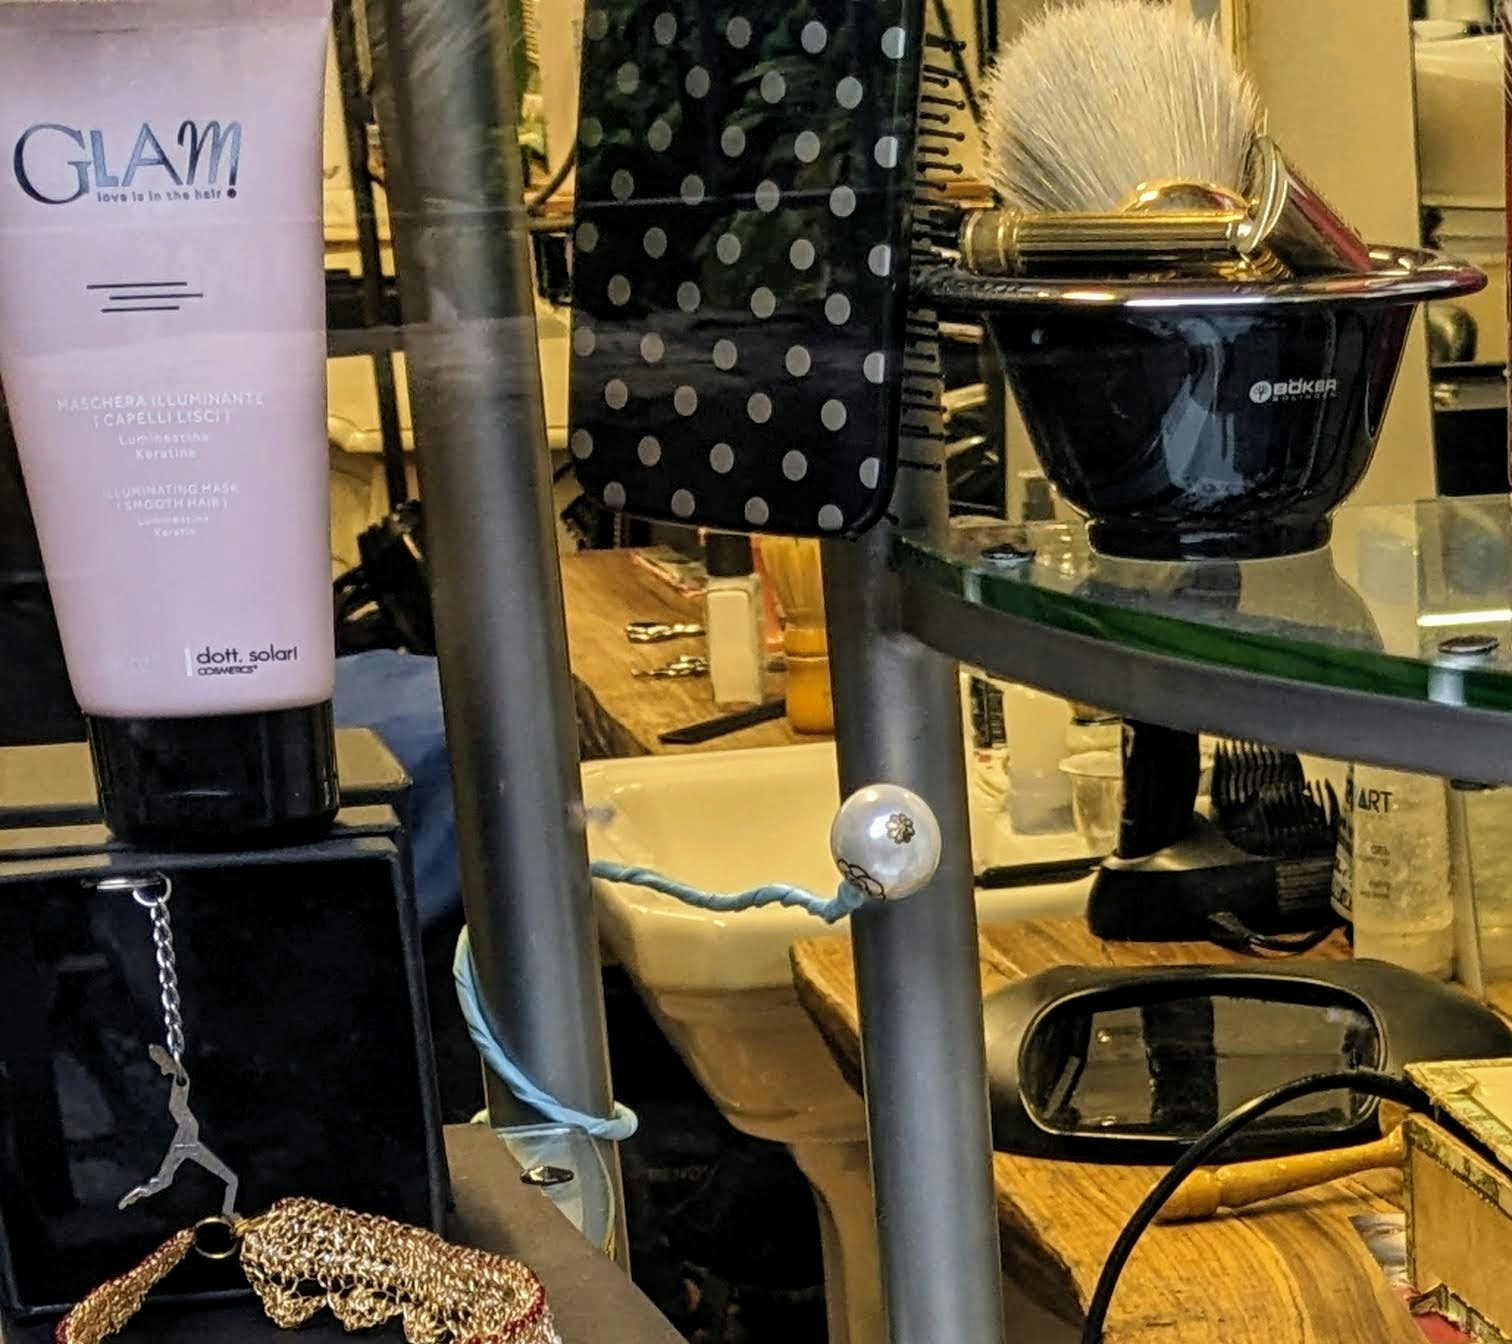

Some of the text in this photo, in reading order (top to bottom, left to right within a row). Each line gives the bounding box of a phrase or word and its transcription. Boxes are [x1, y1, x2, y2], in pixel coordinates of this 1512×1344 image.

[1273, 378, 1337, 396] BÖKER
[197, 643, 298, 664] dott. solari
